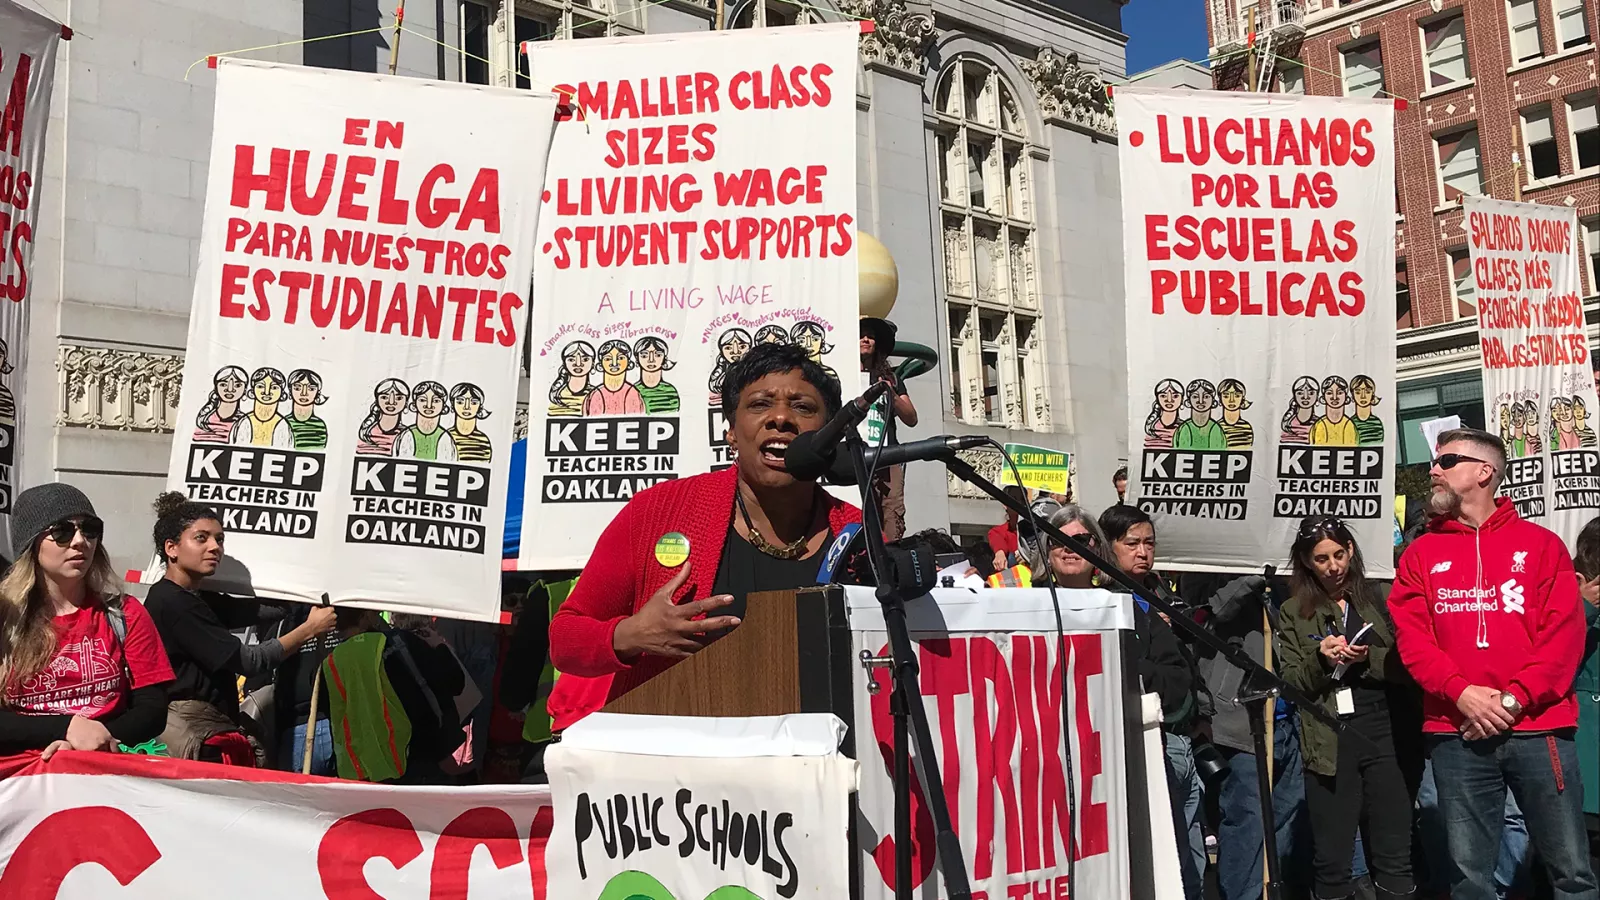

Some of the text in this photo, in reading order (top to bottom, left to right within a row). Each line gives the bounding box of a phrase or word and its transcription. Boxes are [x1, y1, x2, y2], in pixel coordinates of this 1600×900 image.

[552, 62, 834, 122] SMALLER CLASS
[343, 118, 404, 149] EN
[604, 123, 718, 169] SIZES
[1157, 114, 1375, 167] LUCHAMOS
[230, 144, 501, 234] HUELGA
[556, 165, 828, 216] LIVING WAGE
[1192, 171, 1338, 209] POR LAS
[554, 212, 854, 270] STUDENT SUPPORTS
[1146, 214, 1358, 262] ESCUELAS
[1470, 211, 1523, 251] SALARIOS
[225, 217, 512, 280] PARA NUESTROS
[1475, 254, 1553, 292] CLASES MÁS
[219, 263, 524, 347] ESTUDIANTES
[597, 284, 773, 313] A LIVING WAGE
[1151, 269, 1365, 318] PUBLICAS
[1531, 303, 1541, 328] Y
[549, 421, 675, 453] KEEP
[190, 448, 320, 486] KEEP
[547, 455, 674, 472] TEACHERS IN
[1144, 453, 1248, 480] KEEP
[1280, 448, 1380, 476] KEEP
[187, 484, 316, 508] TEACHERS IN
[356, 461, 485, 501] KEEP
[1142, 484, 1246, 498] TEACHERS IN
[1279, 479, 1379, 493] TEACHERS IN
[210, 507, 312, 535] KLAND
[352, 498, 482, 522] TEACHERS IN
[1140, 501, 1243, 520] OAKLAND
[1278, 498, 1378, 516] OAKLAND
[350, 519, 481, 550] OAKLAND
[1434, 599, 1498, 614] Chartered
[1437, 585, 1496, 600] Standard
[75, 685, 93, 697] THE
[94, 677, 121, 693] HEART
[575, 792, 670, 880] PUBLIC
[675, 788, 798, 899] SCHOOLS
